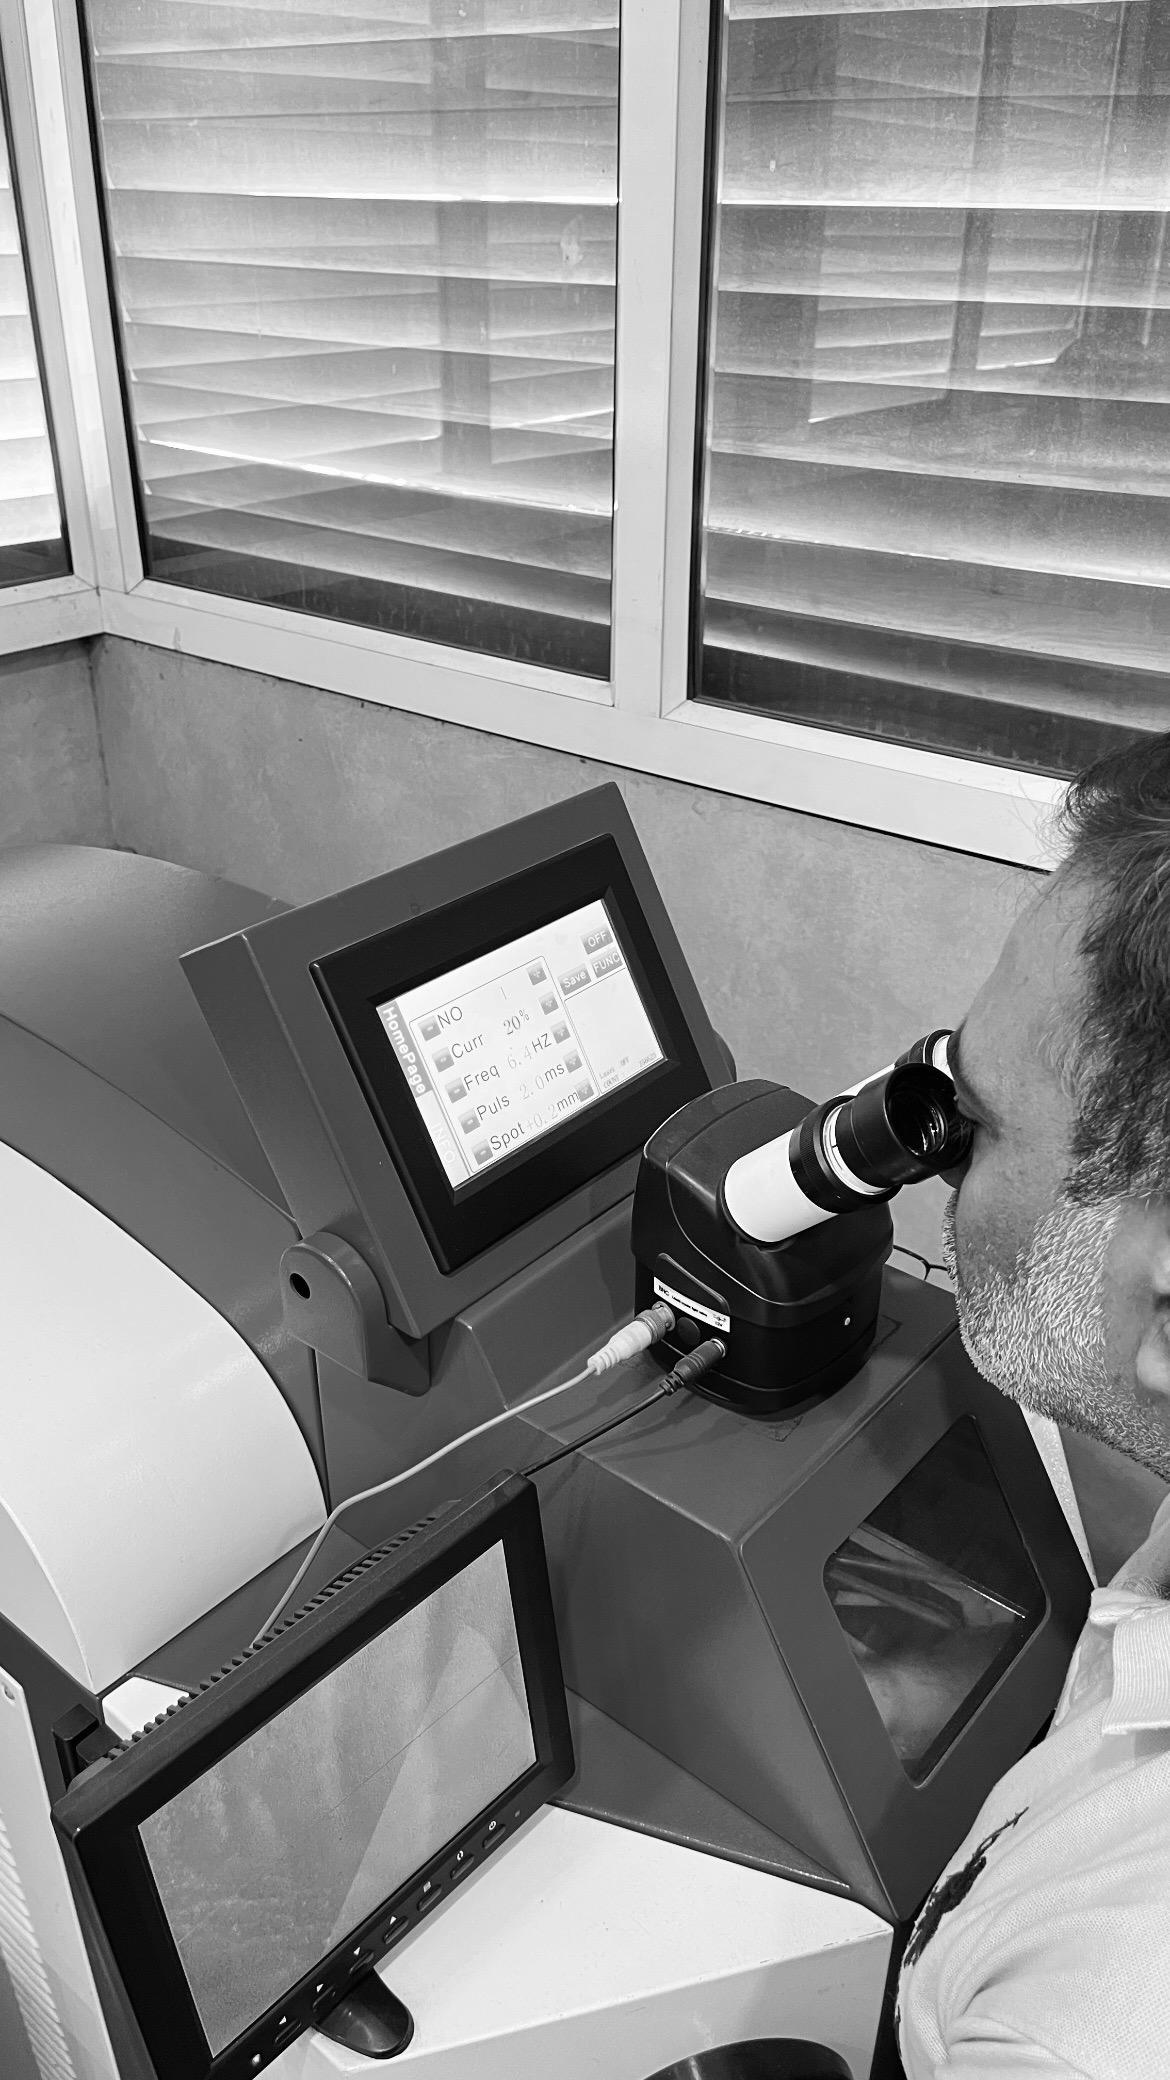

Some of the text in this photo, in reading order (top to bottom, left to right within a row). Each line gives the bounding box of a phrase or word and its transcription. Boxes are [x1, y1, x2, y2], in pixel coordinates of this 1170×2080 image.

[588, 931, 607, 947] OFF
[564, 952, 621, 988] Save FUNC
[437, 1005, 463, 1029] NO
[382, 1006, 426, 1095] HomePage
[451, 1032, 485, 1059] Curr
[463, 1063, 501, 1091] Freq
[532, 1032, 553, 1054] HZ
[476, 1095, 511, 1121] Puls
[543, 1062, 566, 1083] ms
[490, 1122, 526, 1151] Spot
[556, 1091, 580, 1113] mm
